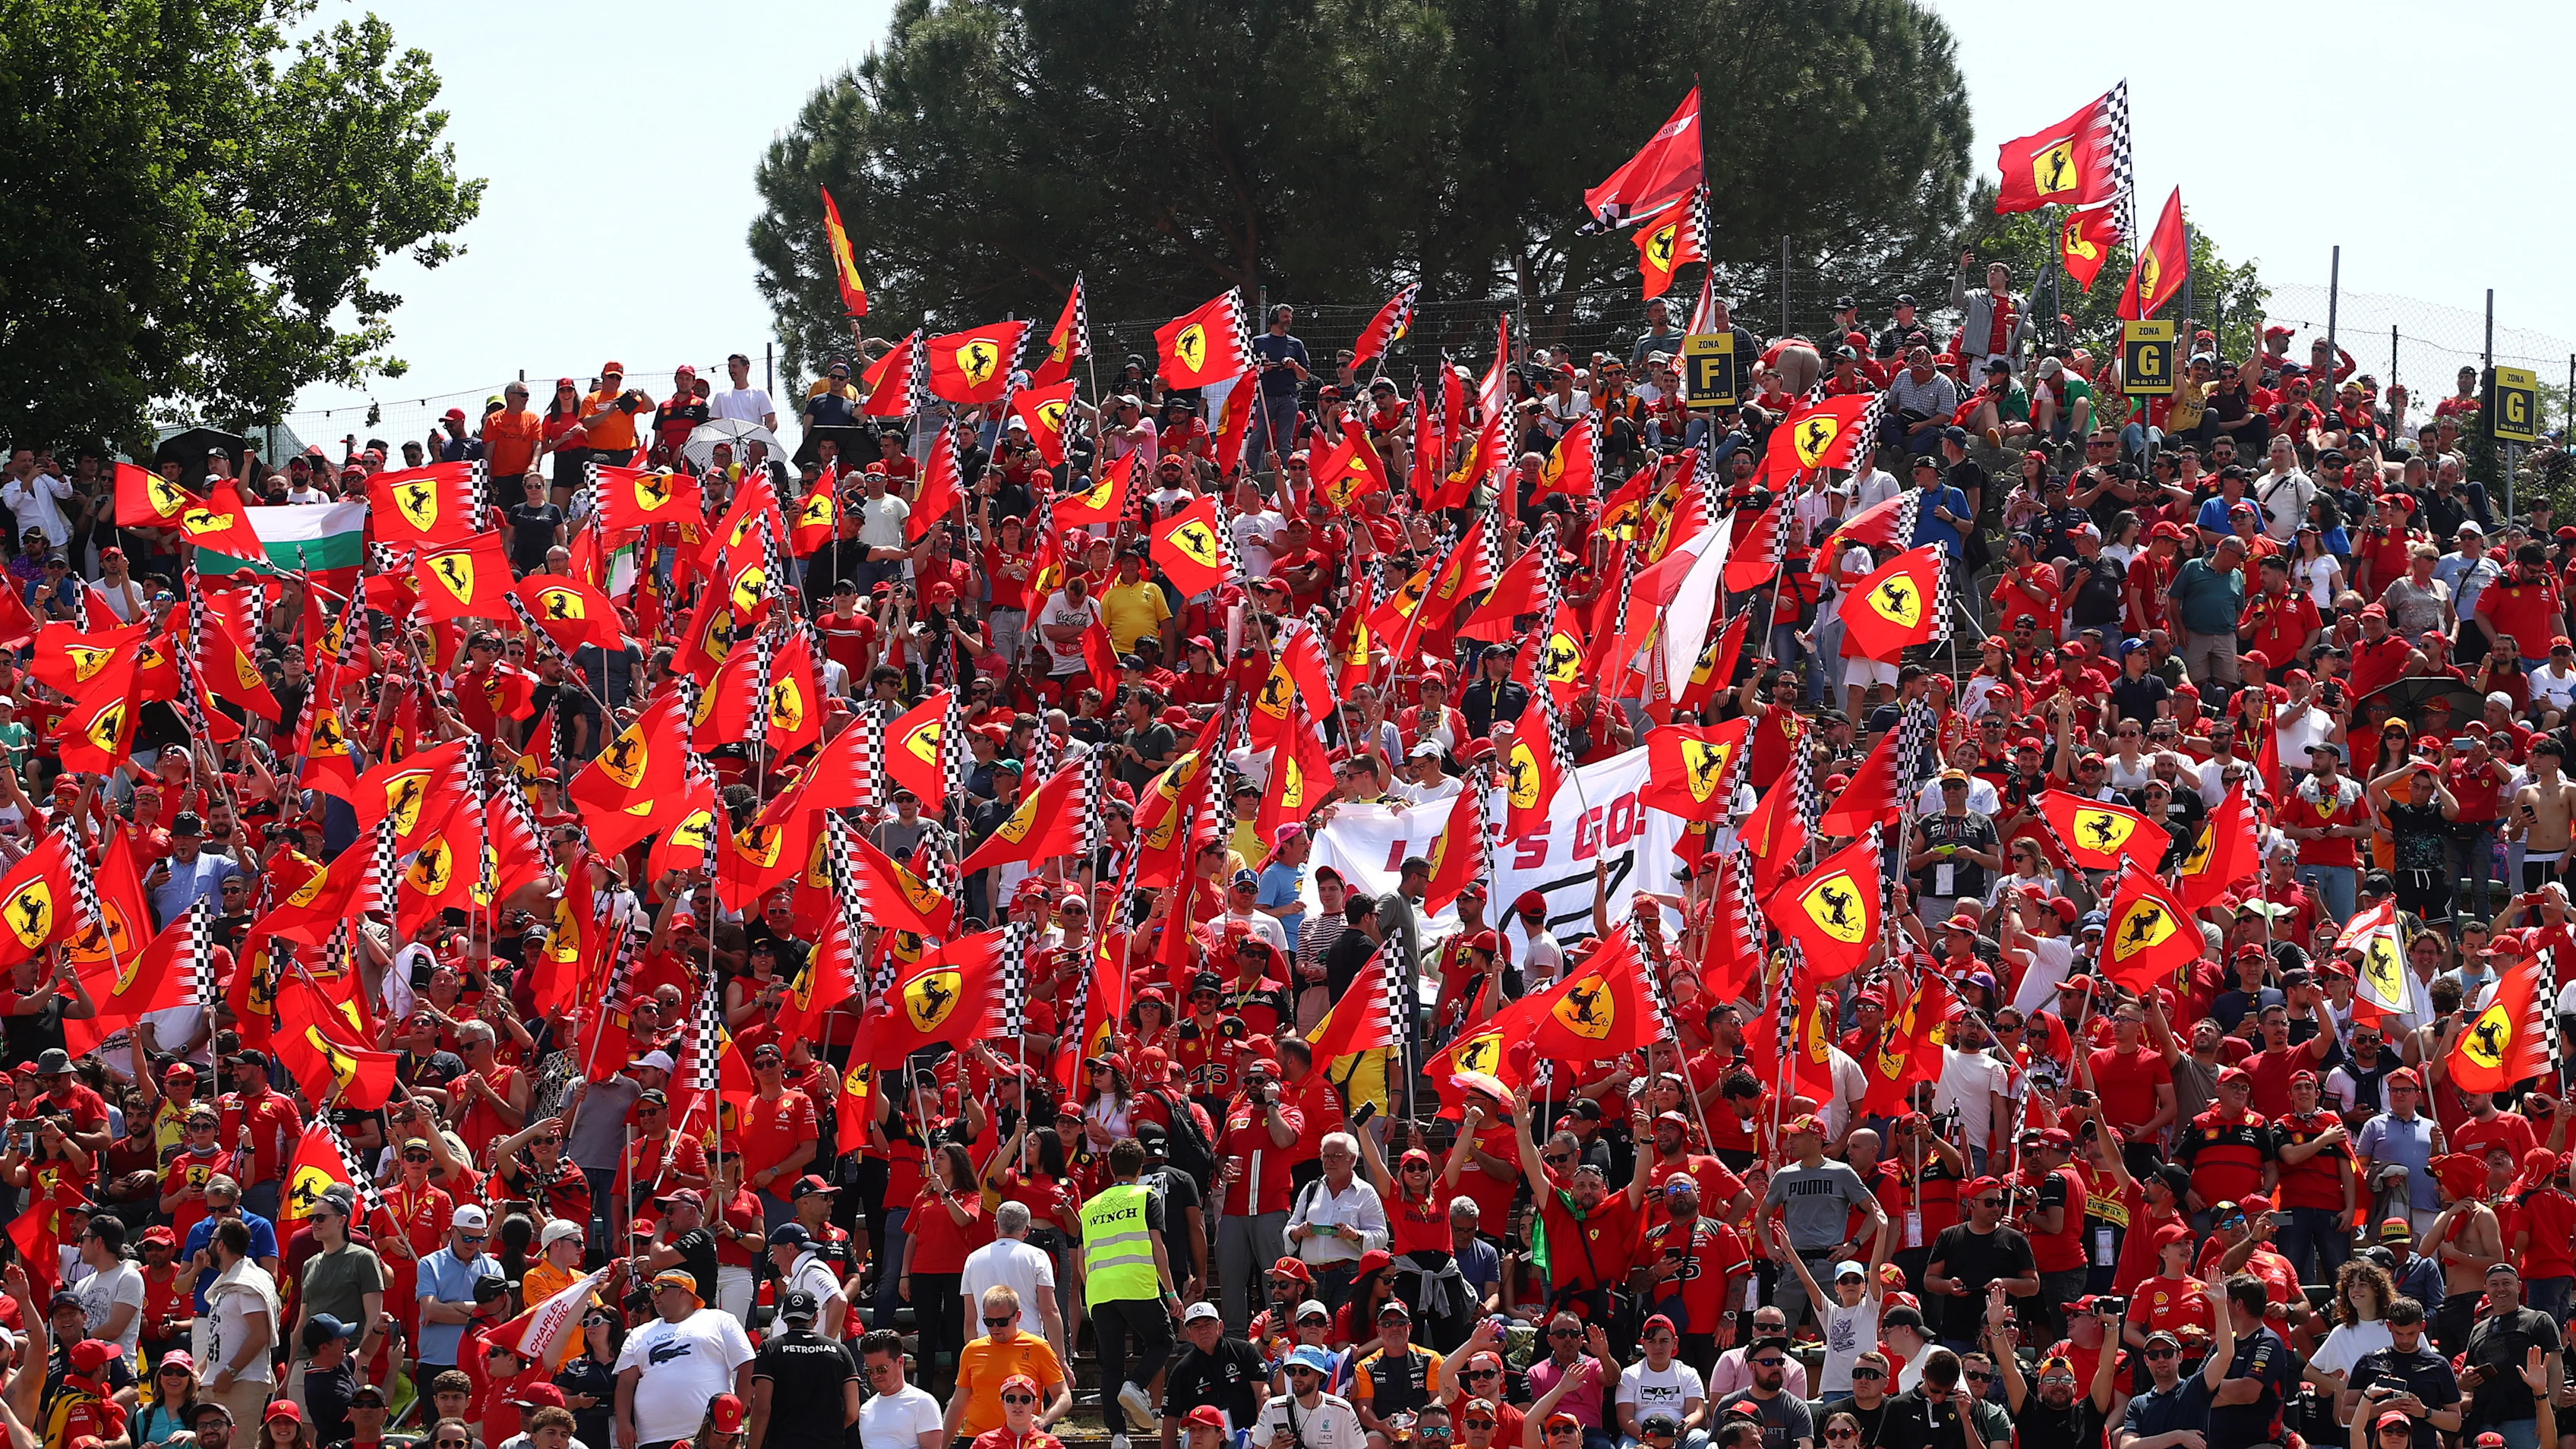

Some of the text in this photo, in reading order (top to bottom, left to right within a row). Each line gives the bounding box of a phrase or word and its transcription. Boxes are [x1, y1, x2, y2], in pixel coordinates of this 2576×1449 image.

[2139, 327, 2160, 336] ZONA
[1698, 340, 1719, 349] ZONA
[2138, 344, 2160, 376] G
[1700, 358, 1720, 390] F
[2507, 373, 2524, 384] ZONA
[2506, 391, 2524, 424] G
[1961, 685, 1977, 710] ARLOS
[113, 1037, 131, 1046] ANGELE
[1788, 1179, 1833, 1197] PUMA
[530, 1298, 563, 1352] CHARLES
[538, 1302, 570, 1358] LECLERC
[646, 1330, 695, 1346] LACOSTE
[782, 1345, 837, 1353] PETRONAS
[1640, 1385, 1679, 1401] EA7
